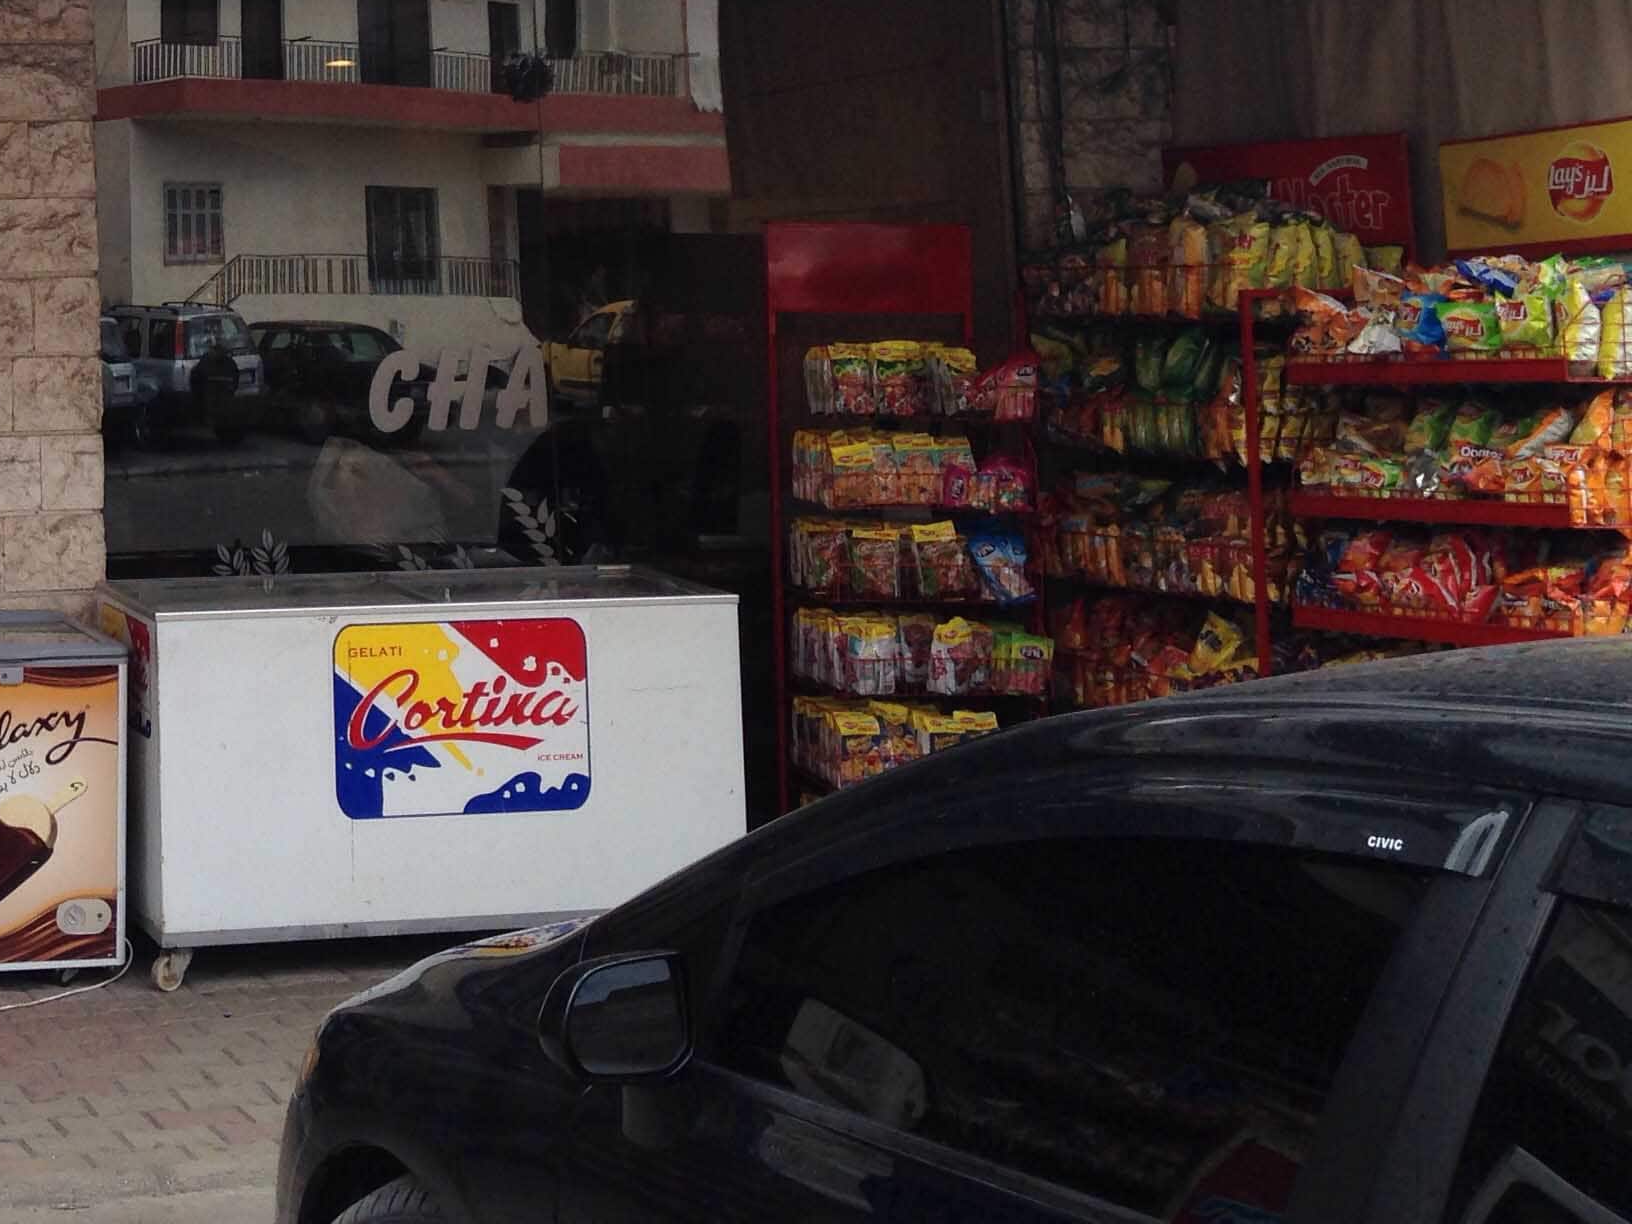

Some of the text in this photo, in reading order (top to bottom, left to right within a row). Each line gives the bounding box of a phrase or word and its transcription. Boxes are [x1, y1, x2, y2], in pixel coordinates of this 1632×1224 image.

[368, 343, 550, 433] CHA
[348, 646, 403, 659] GELATI
[348, 668, 577, 752] Cortina
[1367, 836, 1403, 850] CIVIC
